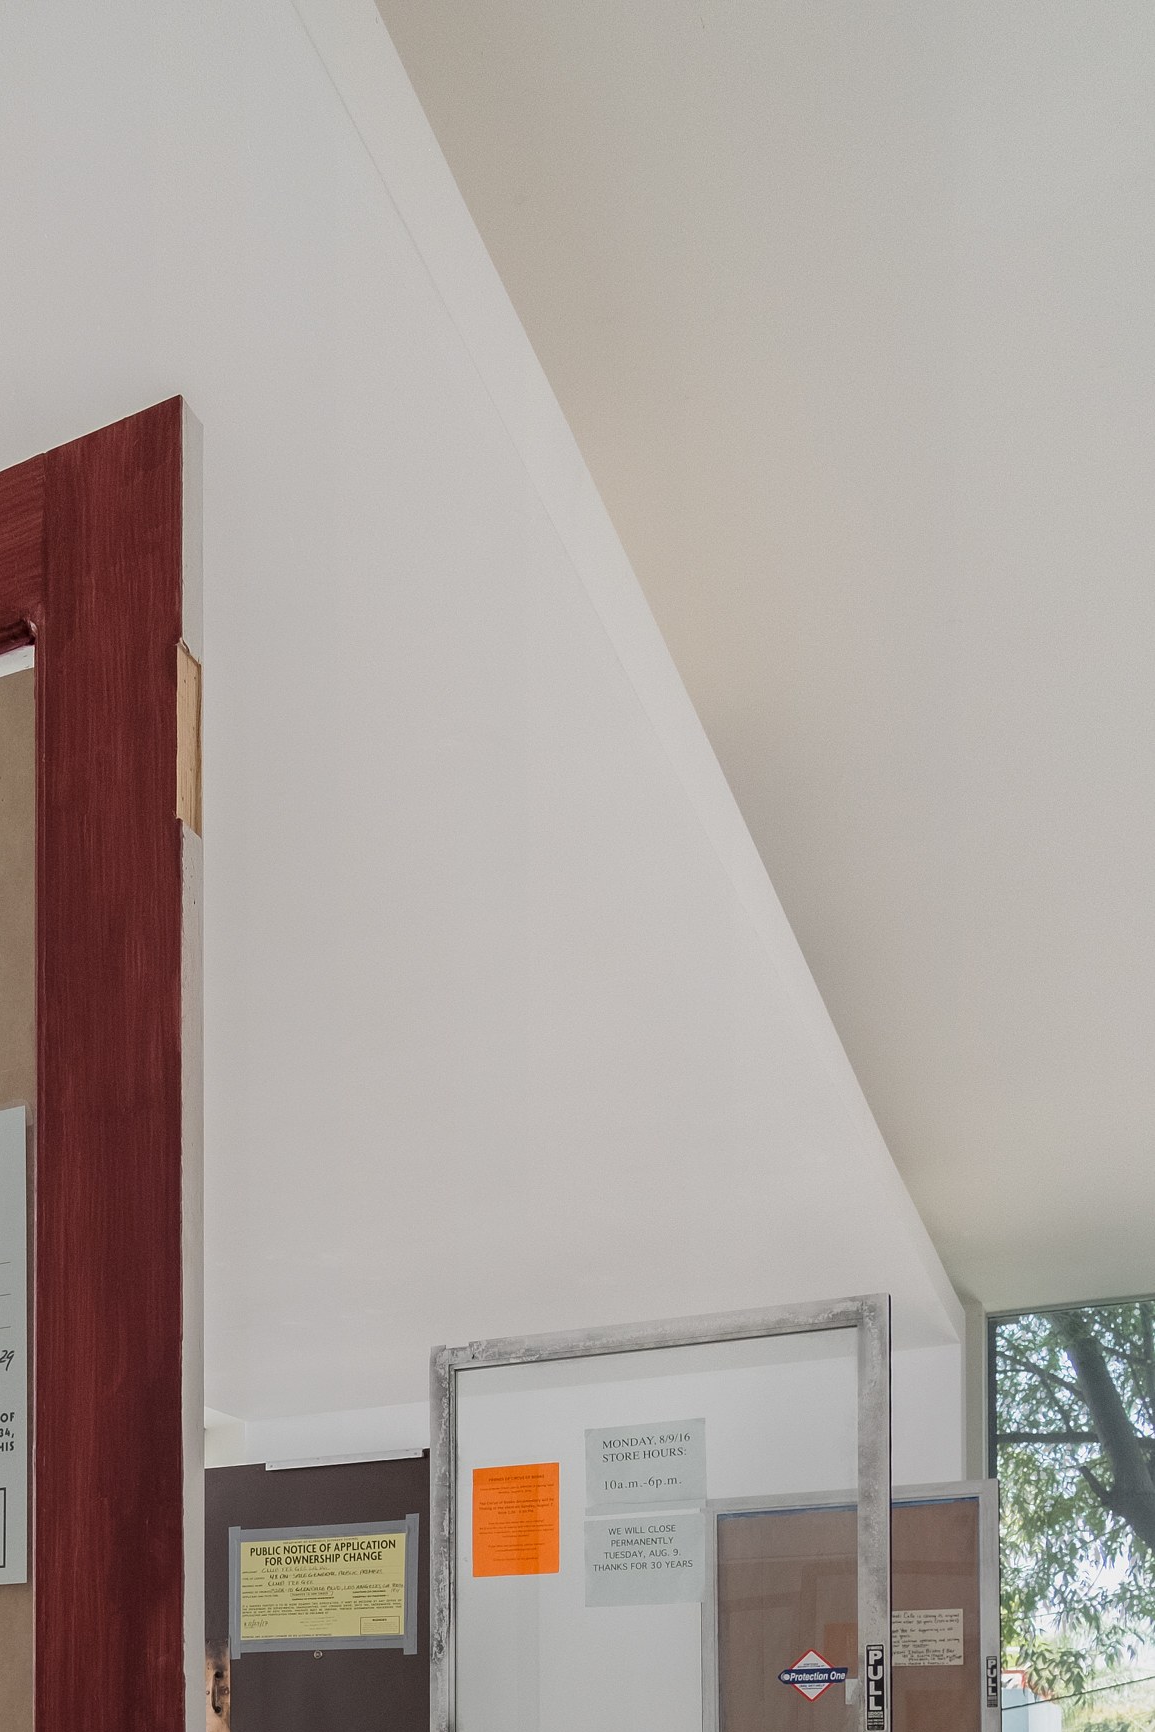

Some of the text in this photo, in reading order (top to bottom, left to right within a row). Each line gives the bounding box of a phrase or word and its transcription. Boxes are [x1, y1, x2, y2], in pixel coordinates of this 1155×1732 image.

[0, 1411, 16, 1424] OF
[602, 1432, 691, 1450] MONDAY, 8/9/16
[602, 1447, 687, 1463] STORE HOURS:
[624, 1526, 645, 1534] WILL
[648, 1524, 676, 1533] CLOSE
[250, 1546, 281, 1557] PUBLIC
[283, 1544, 317, 1555] NOTICE
[319, 1543, 332, 1553] OF
[333, 1540, 396, 1553] APPLICATION
[610, 1536, 674, 1548] PERMANENTLY
[264, 1551, 383, 1566] FOR OWNERSHIP CHANGE
[604, 1550, 646, 1560] TUESDAY,
[649, 1549, 670, 1557] AUG.
[593, 1559, 693, 1572] THANKS FOR 30 YEARS
[789, 1671, 846, 1682] Protection One
[868, 1650, 883, 1711] PULL
[987, 1659, 997, 1696] PULL
